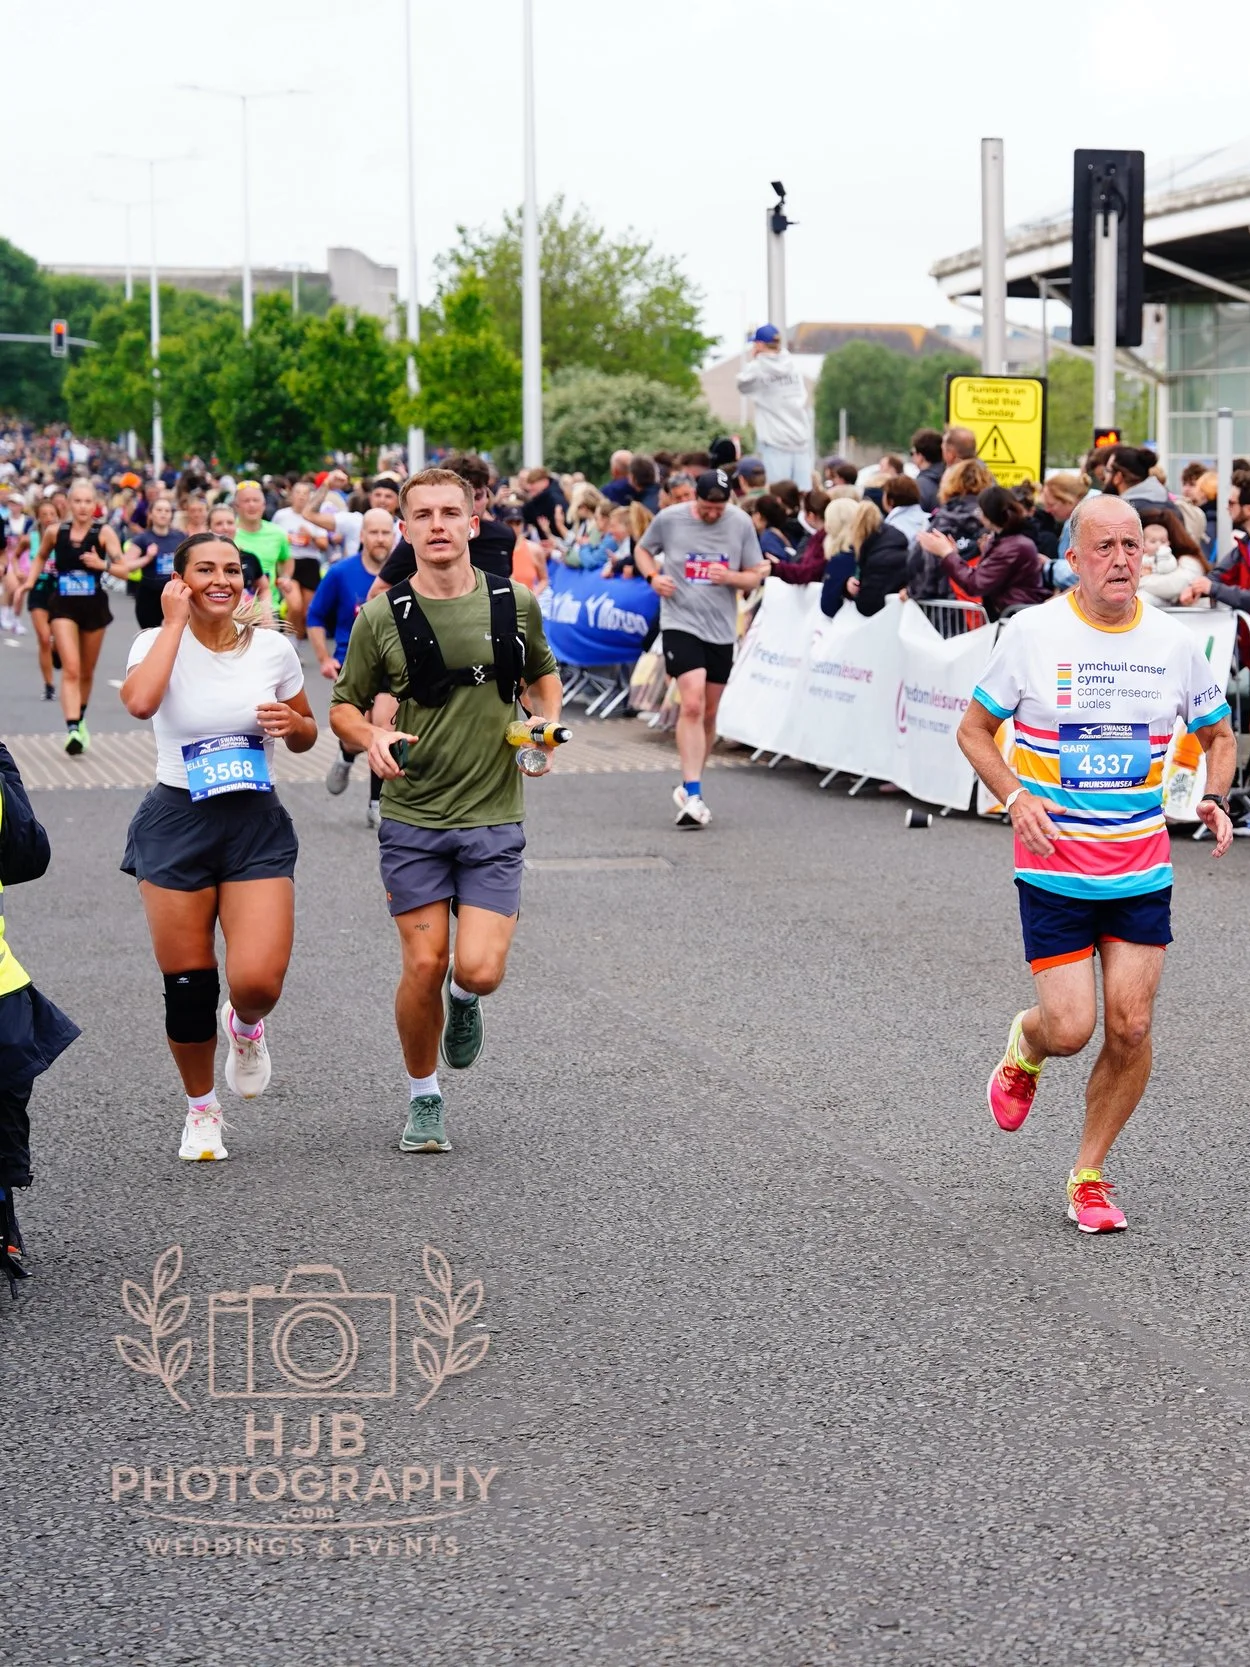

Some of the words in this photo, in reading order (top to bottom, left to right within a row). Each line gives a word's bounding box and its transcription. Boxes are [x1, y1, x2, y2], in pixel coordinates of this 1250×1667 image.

[967, 383, 1009, 394] Runners
[972, 396, 999, 405] Road
[977, 407, 1015, 418] Sunday
[1077, 661, 1128, 674] ymchwil
[1130, 663, 1166, 675] canser
[1077, 674, 1115, 686] cymru
[1077, 686, 1116, 698] cancer
[1117, 687, 1162, 700] research
[1077, 698, 1111, 709] wales
[1103, 724, 1133, 732] SWANSEA
[1061, 744, 1090, 753] GARY
[186, 757, 210, 772] ELLE
[1077, 753, 1134, 775] 4337
[203, 760, 254, 784] 3568
[207, 781, 258, 797] #RUNSWANSEA
[1078, 780, 1133, 789] #RUNSWANSEA
